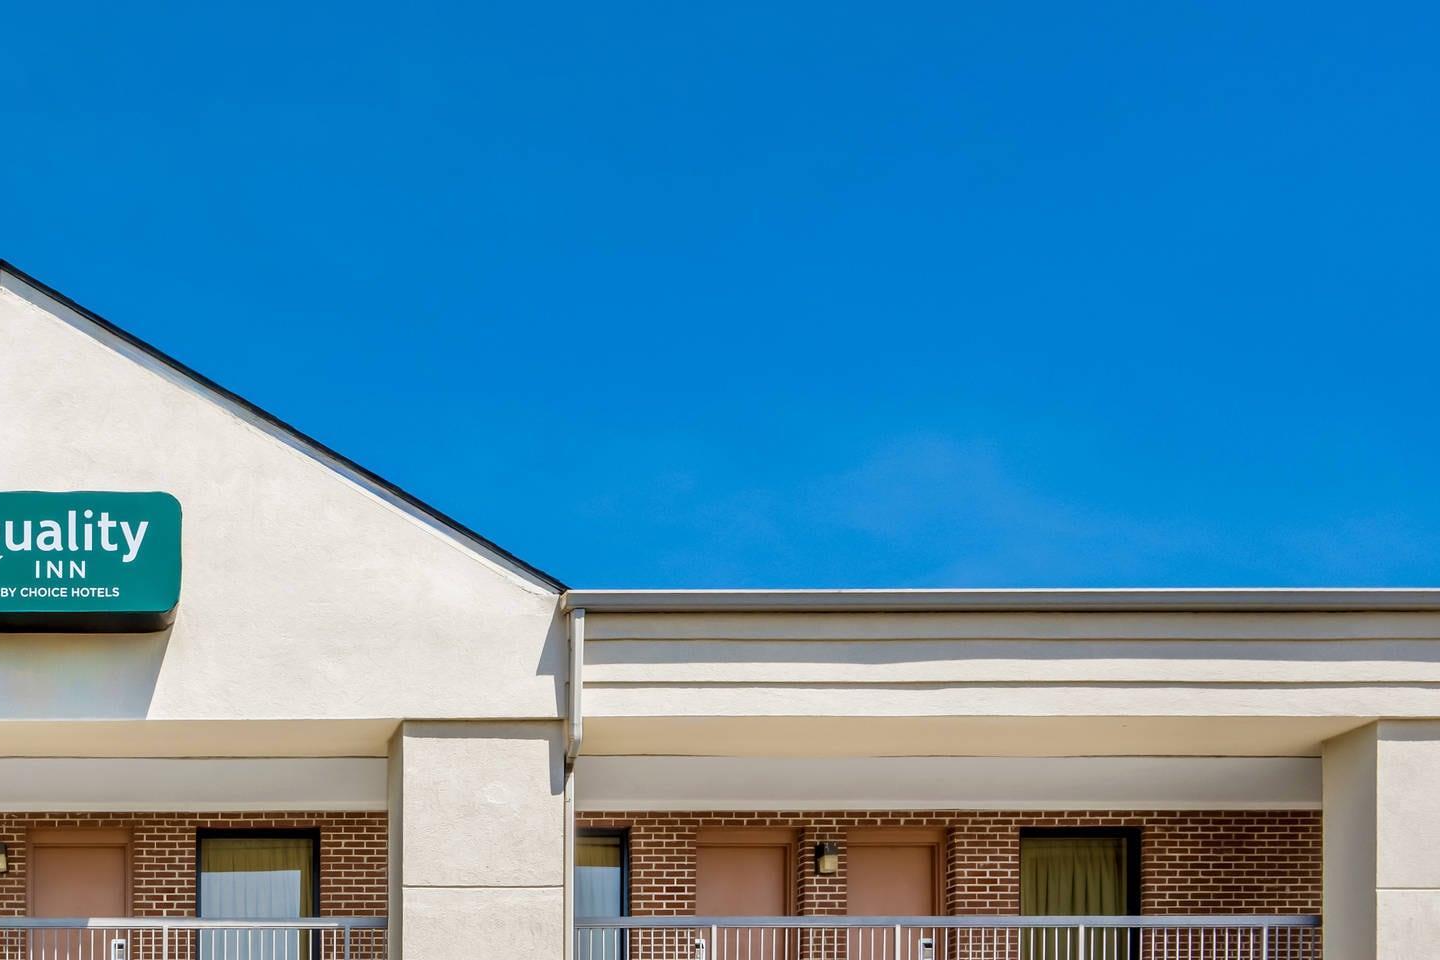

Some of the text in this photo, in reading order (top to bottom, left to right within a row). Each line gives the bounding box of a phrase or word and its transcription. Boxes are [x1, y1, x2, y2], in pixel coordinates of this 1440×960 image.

[35, 560, 86, 579] INN
[0, 587, 120, 598] BY CHOICE HOTELS
